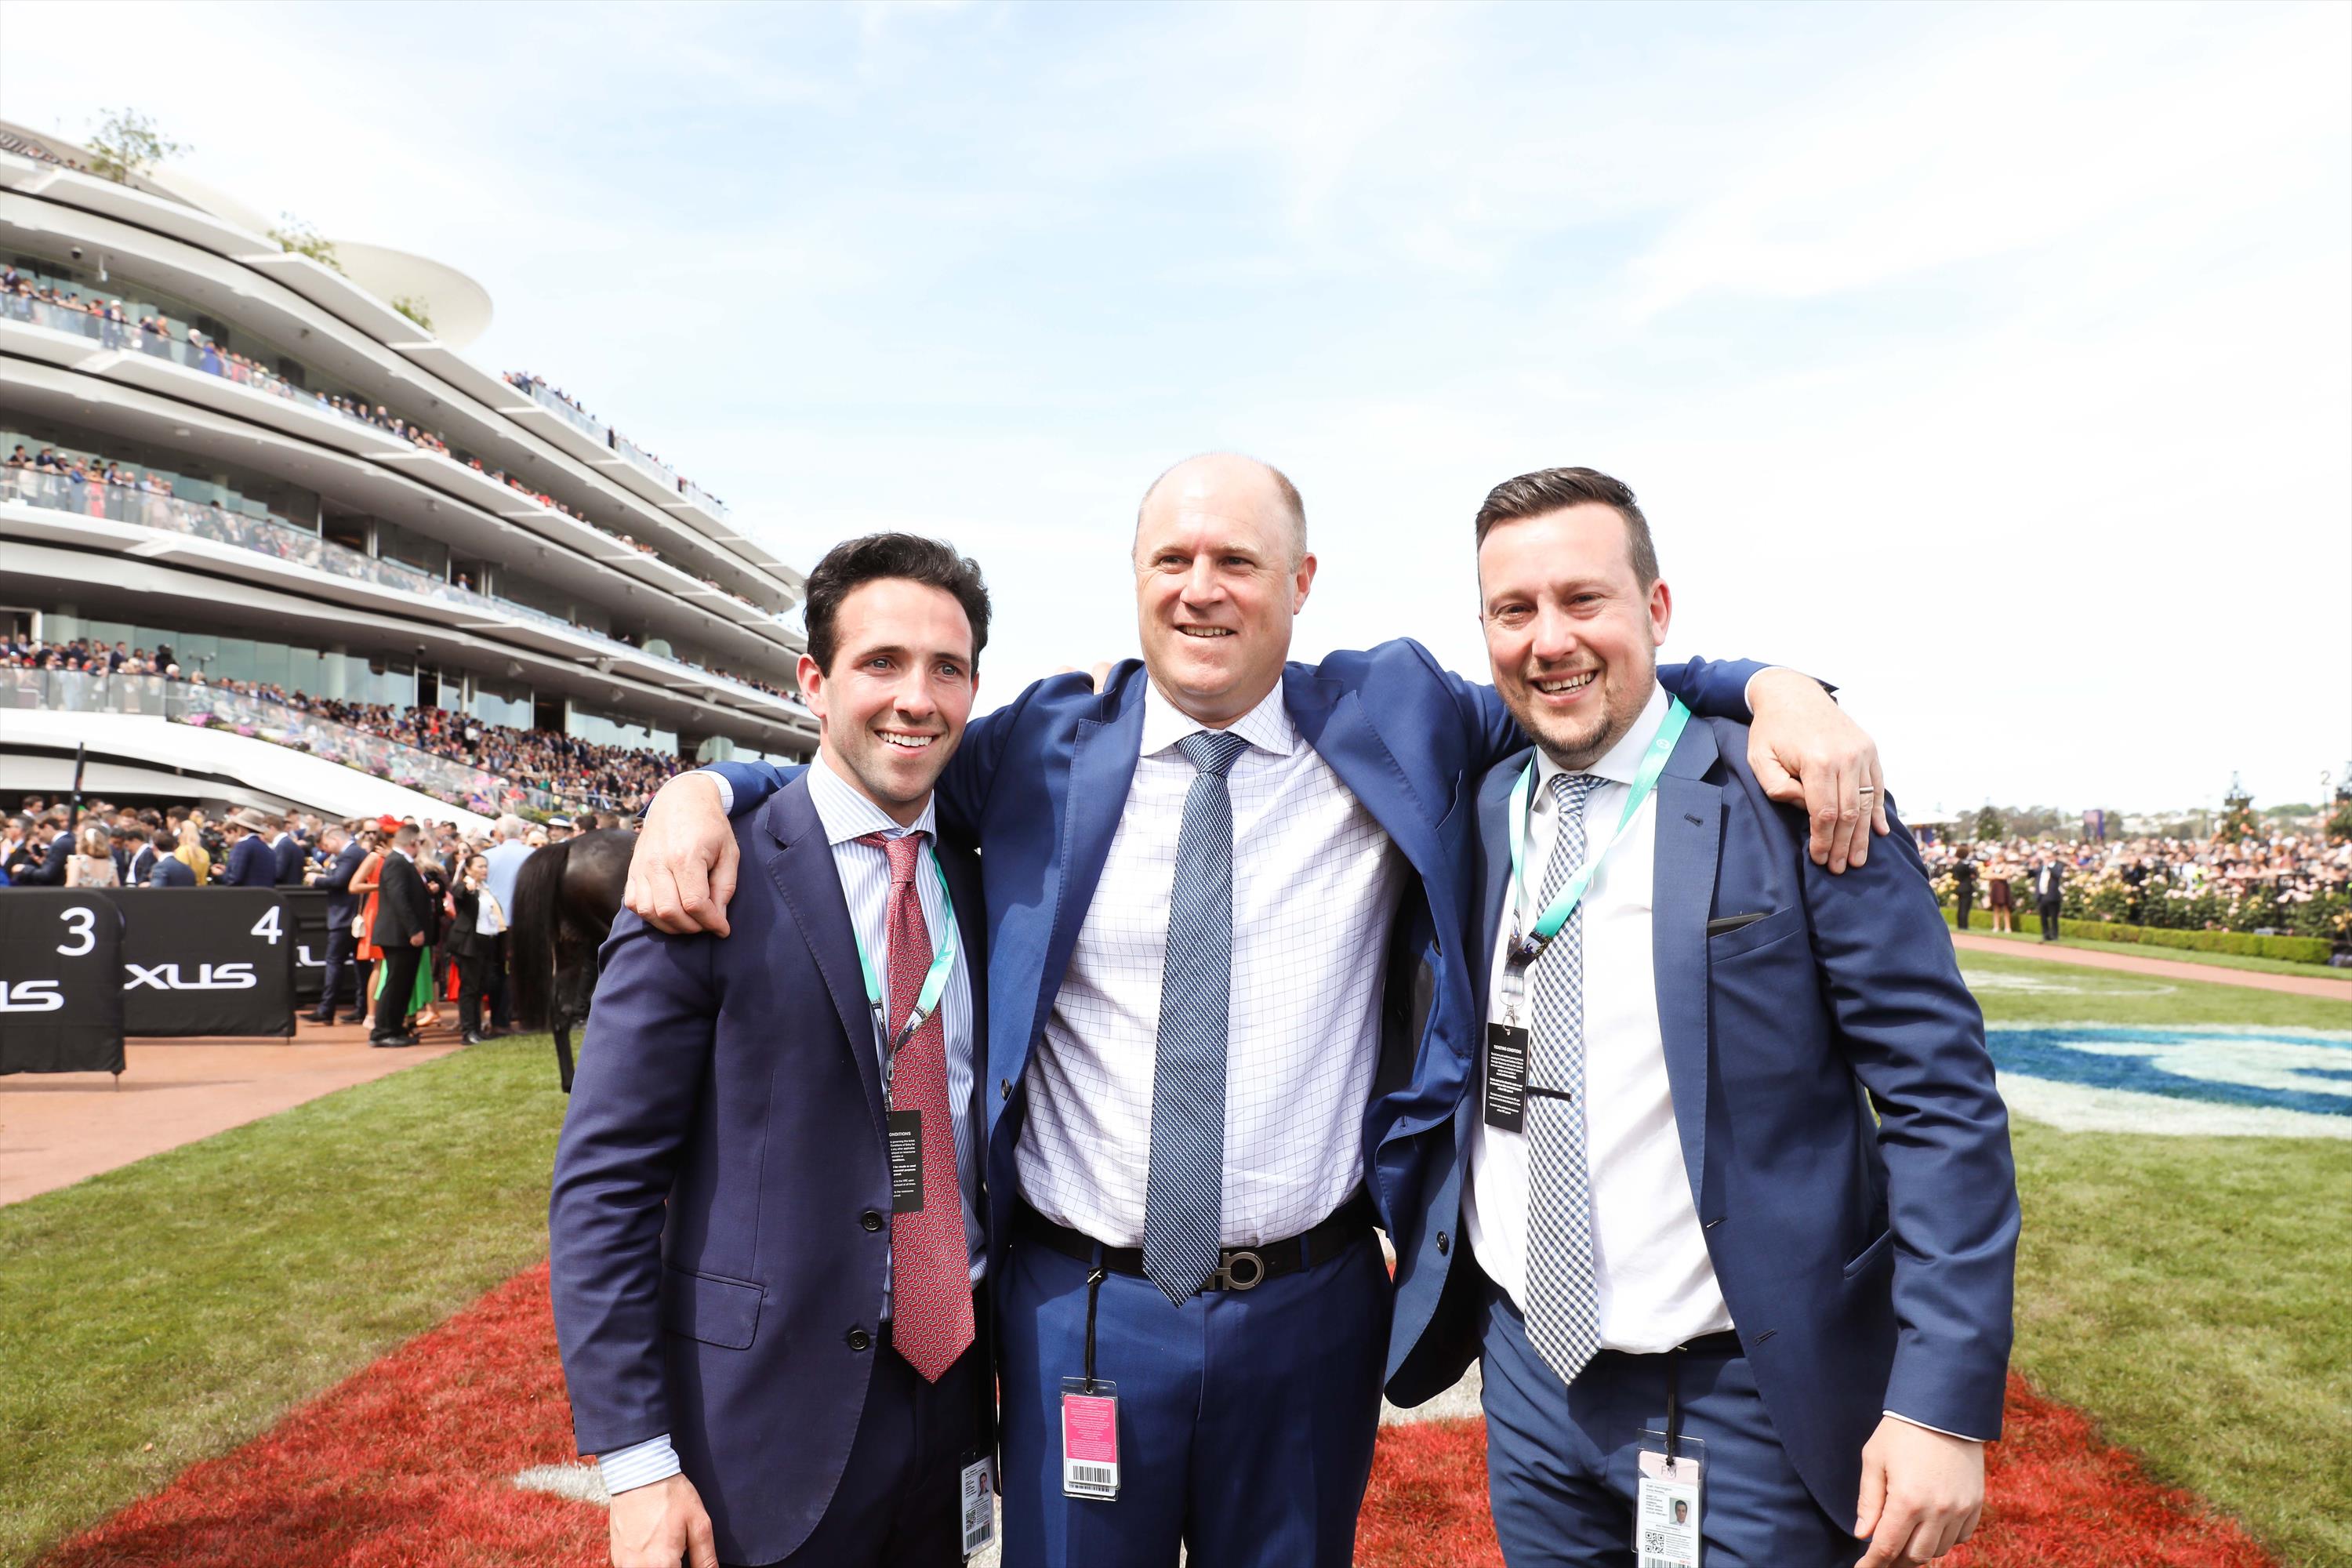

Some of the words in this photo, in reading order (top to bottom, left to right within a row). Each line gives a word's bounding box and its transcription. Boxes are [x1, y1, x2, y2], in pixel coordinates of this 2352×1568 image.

[2321, 770, 2332, 786] 2
[56, 906, 96, 956] 3
[250, 906, 283, 945] 4
[123, 963, 257, 990] XUS
[0, 980, 64, 1012] S
